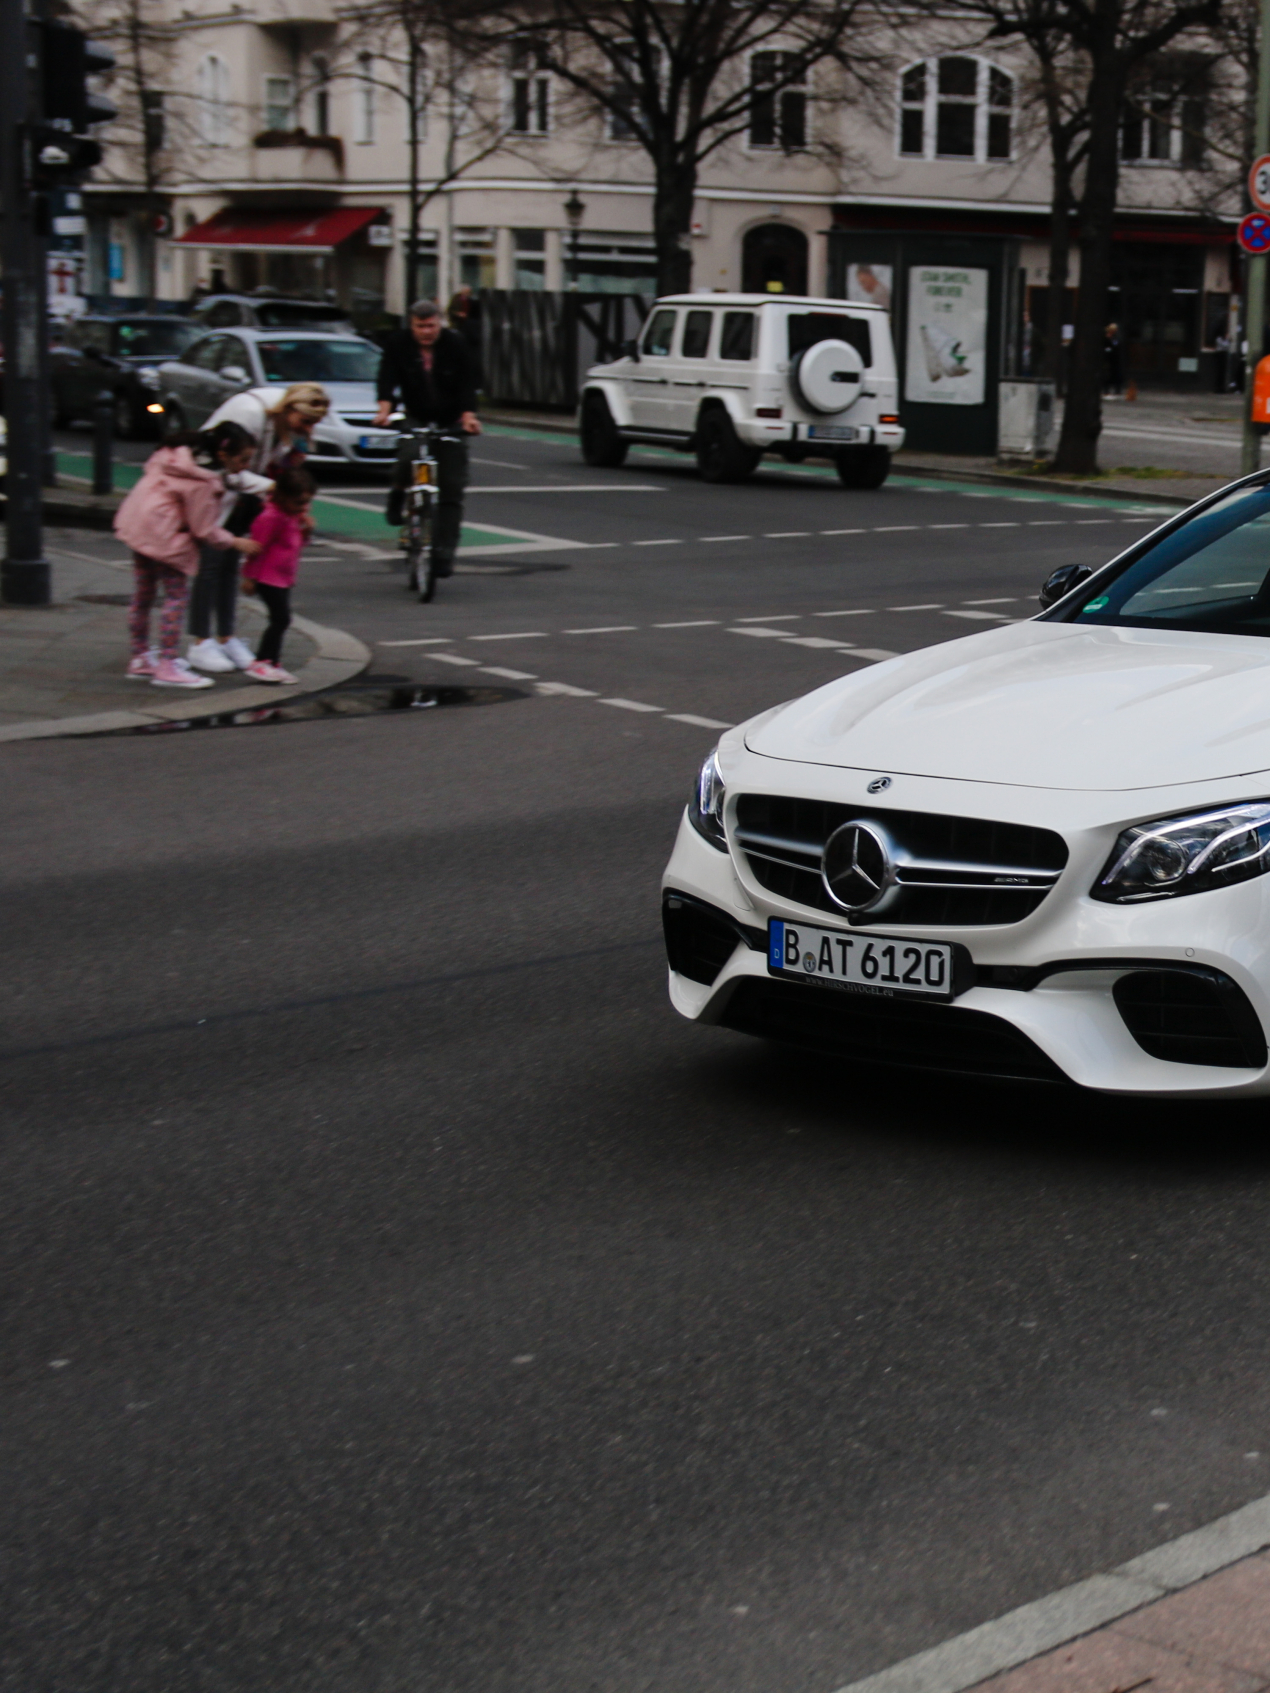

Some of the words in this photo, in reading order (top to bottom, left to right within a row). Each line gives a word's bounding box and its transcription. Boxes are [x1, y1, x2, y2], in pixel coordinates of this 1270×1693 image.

[784, 928, 800, 966] B
[817, 936, 854, 976] AT
[860, 942, 946, 987] 6120
